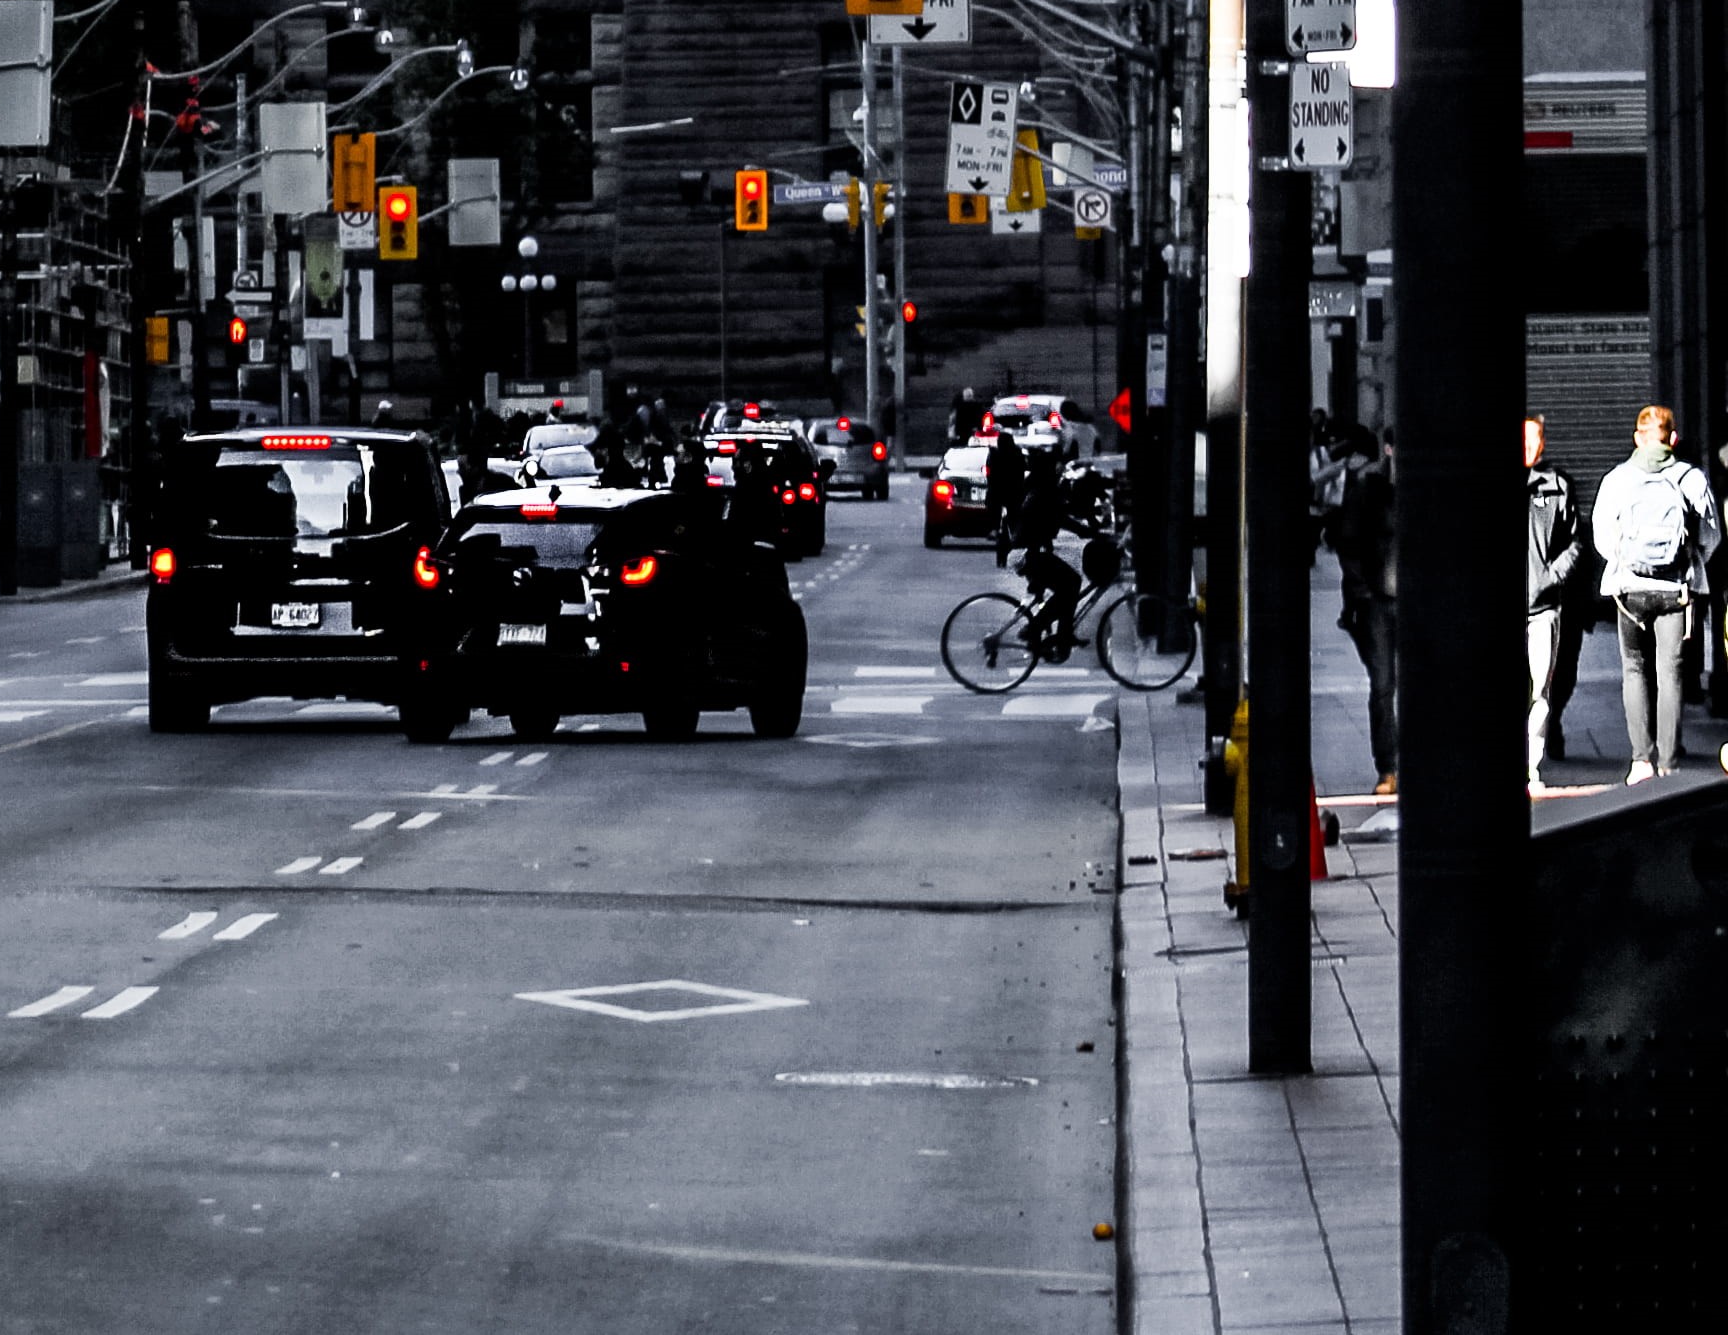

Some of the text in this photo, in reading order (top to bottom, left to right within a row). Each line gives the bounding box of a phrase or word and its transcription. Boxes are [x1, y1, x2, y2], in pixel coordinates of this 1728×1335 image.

[1311, 68, 1330, 94] NO
[1292, 100, 1349, 128] STANDING
[785, 186, 822, 200] Queen
